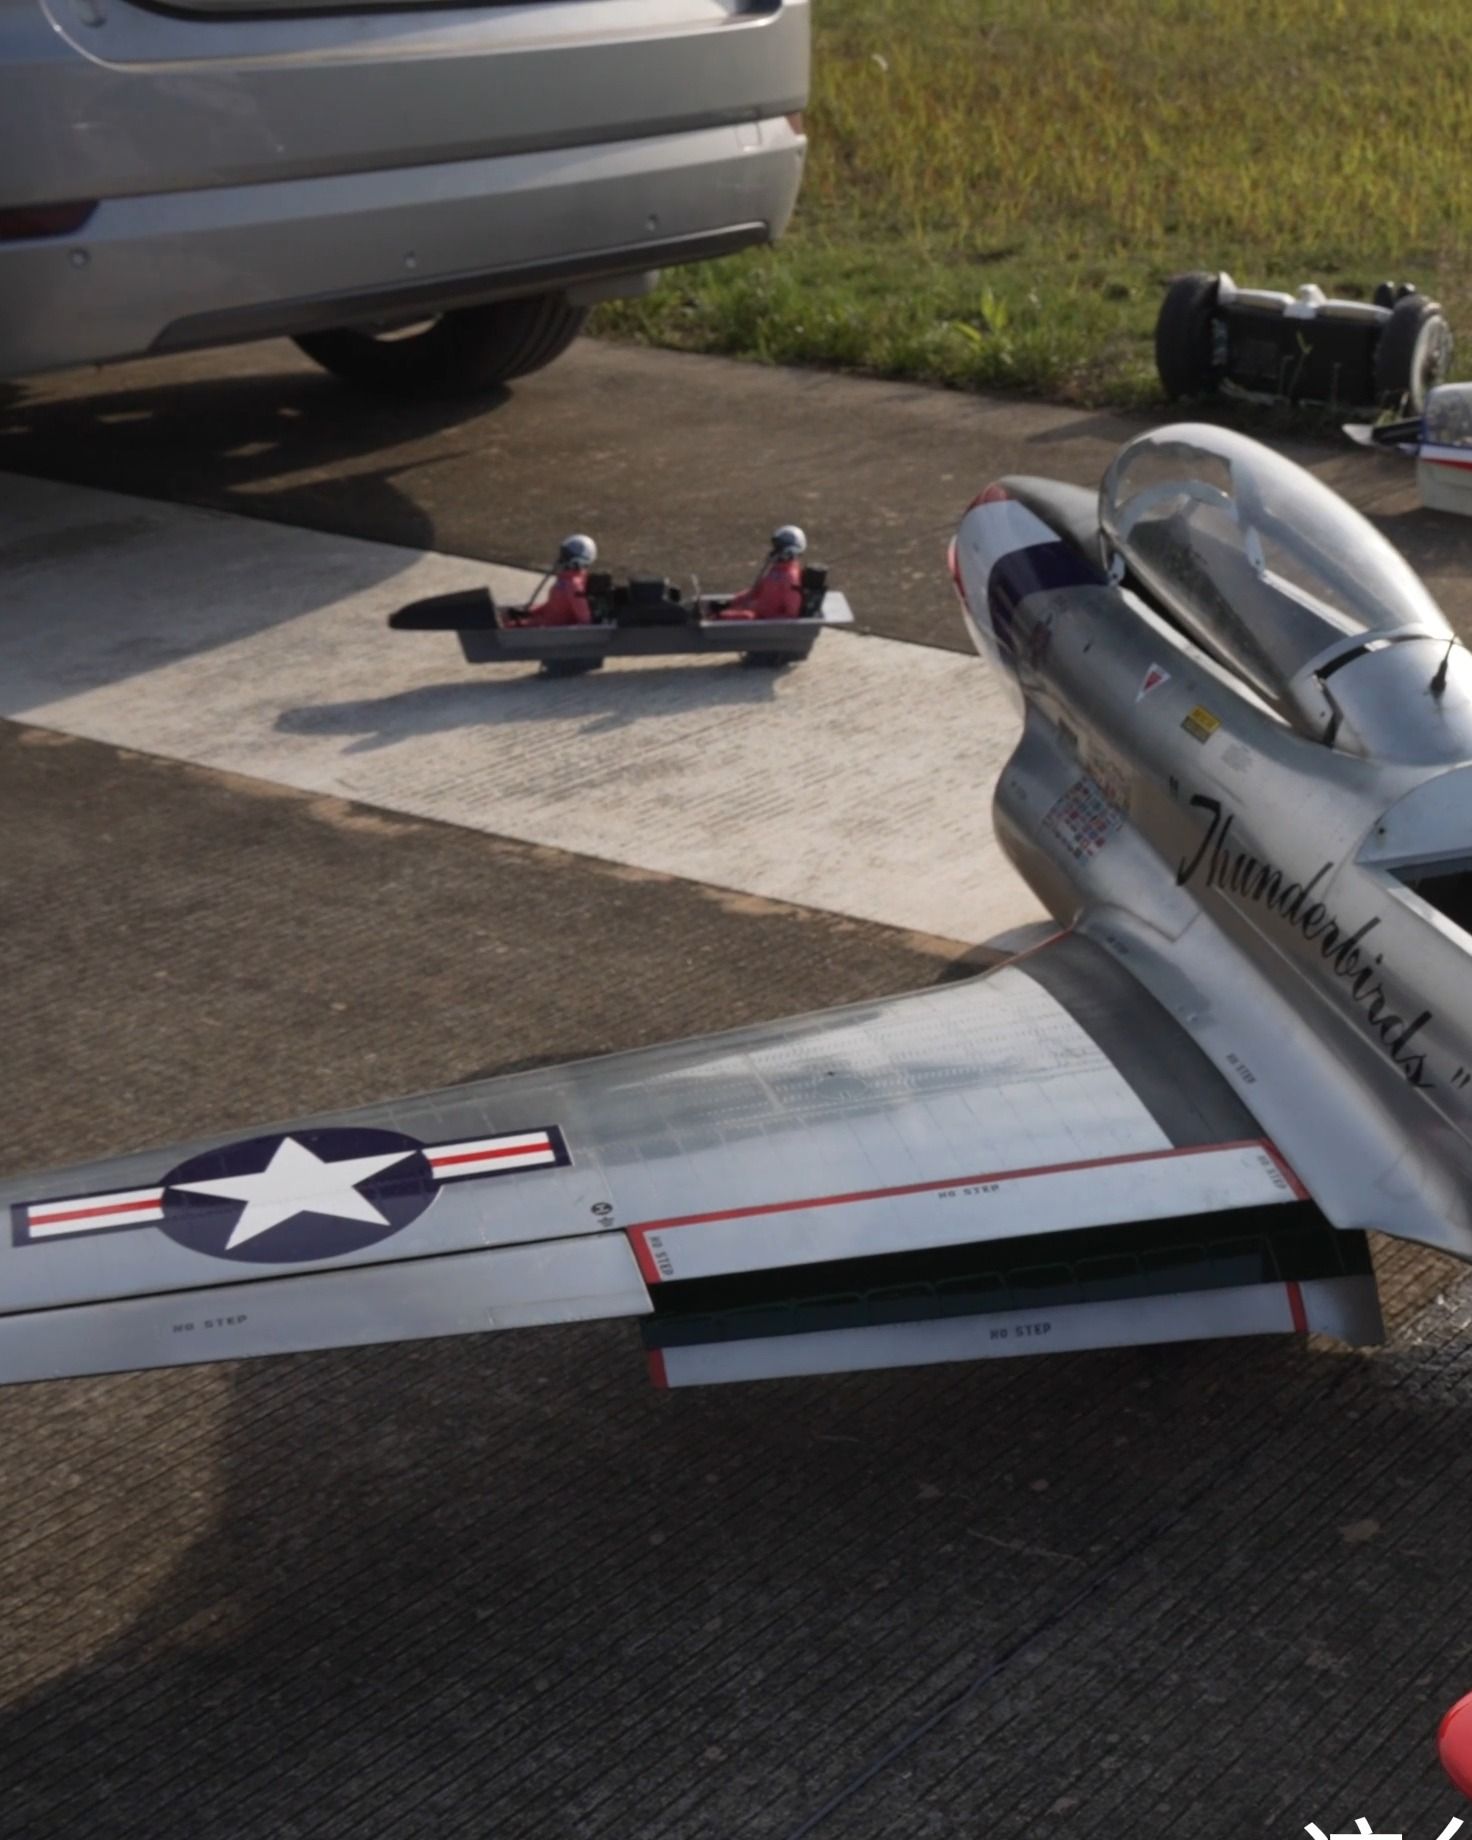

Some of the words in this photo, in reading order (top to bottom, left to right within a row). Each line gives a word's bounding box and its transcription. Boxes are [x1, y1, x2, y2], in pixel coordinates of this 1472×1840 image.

[963, 1183, 999, 1195] STEP
[656, 1251, 674, 1276] STEP
[204, 1314, 248, 1329] STEP
[990, 1328, 1008, 1340] NO
[1015, 1322, 1051, 1336] STEP
